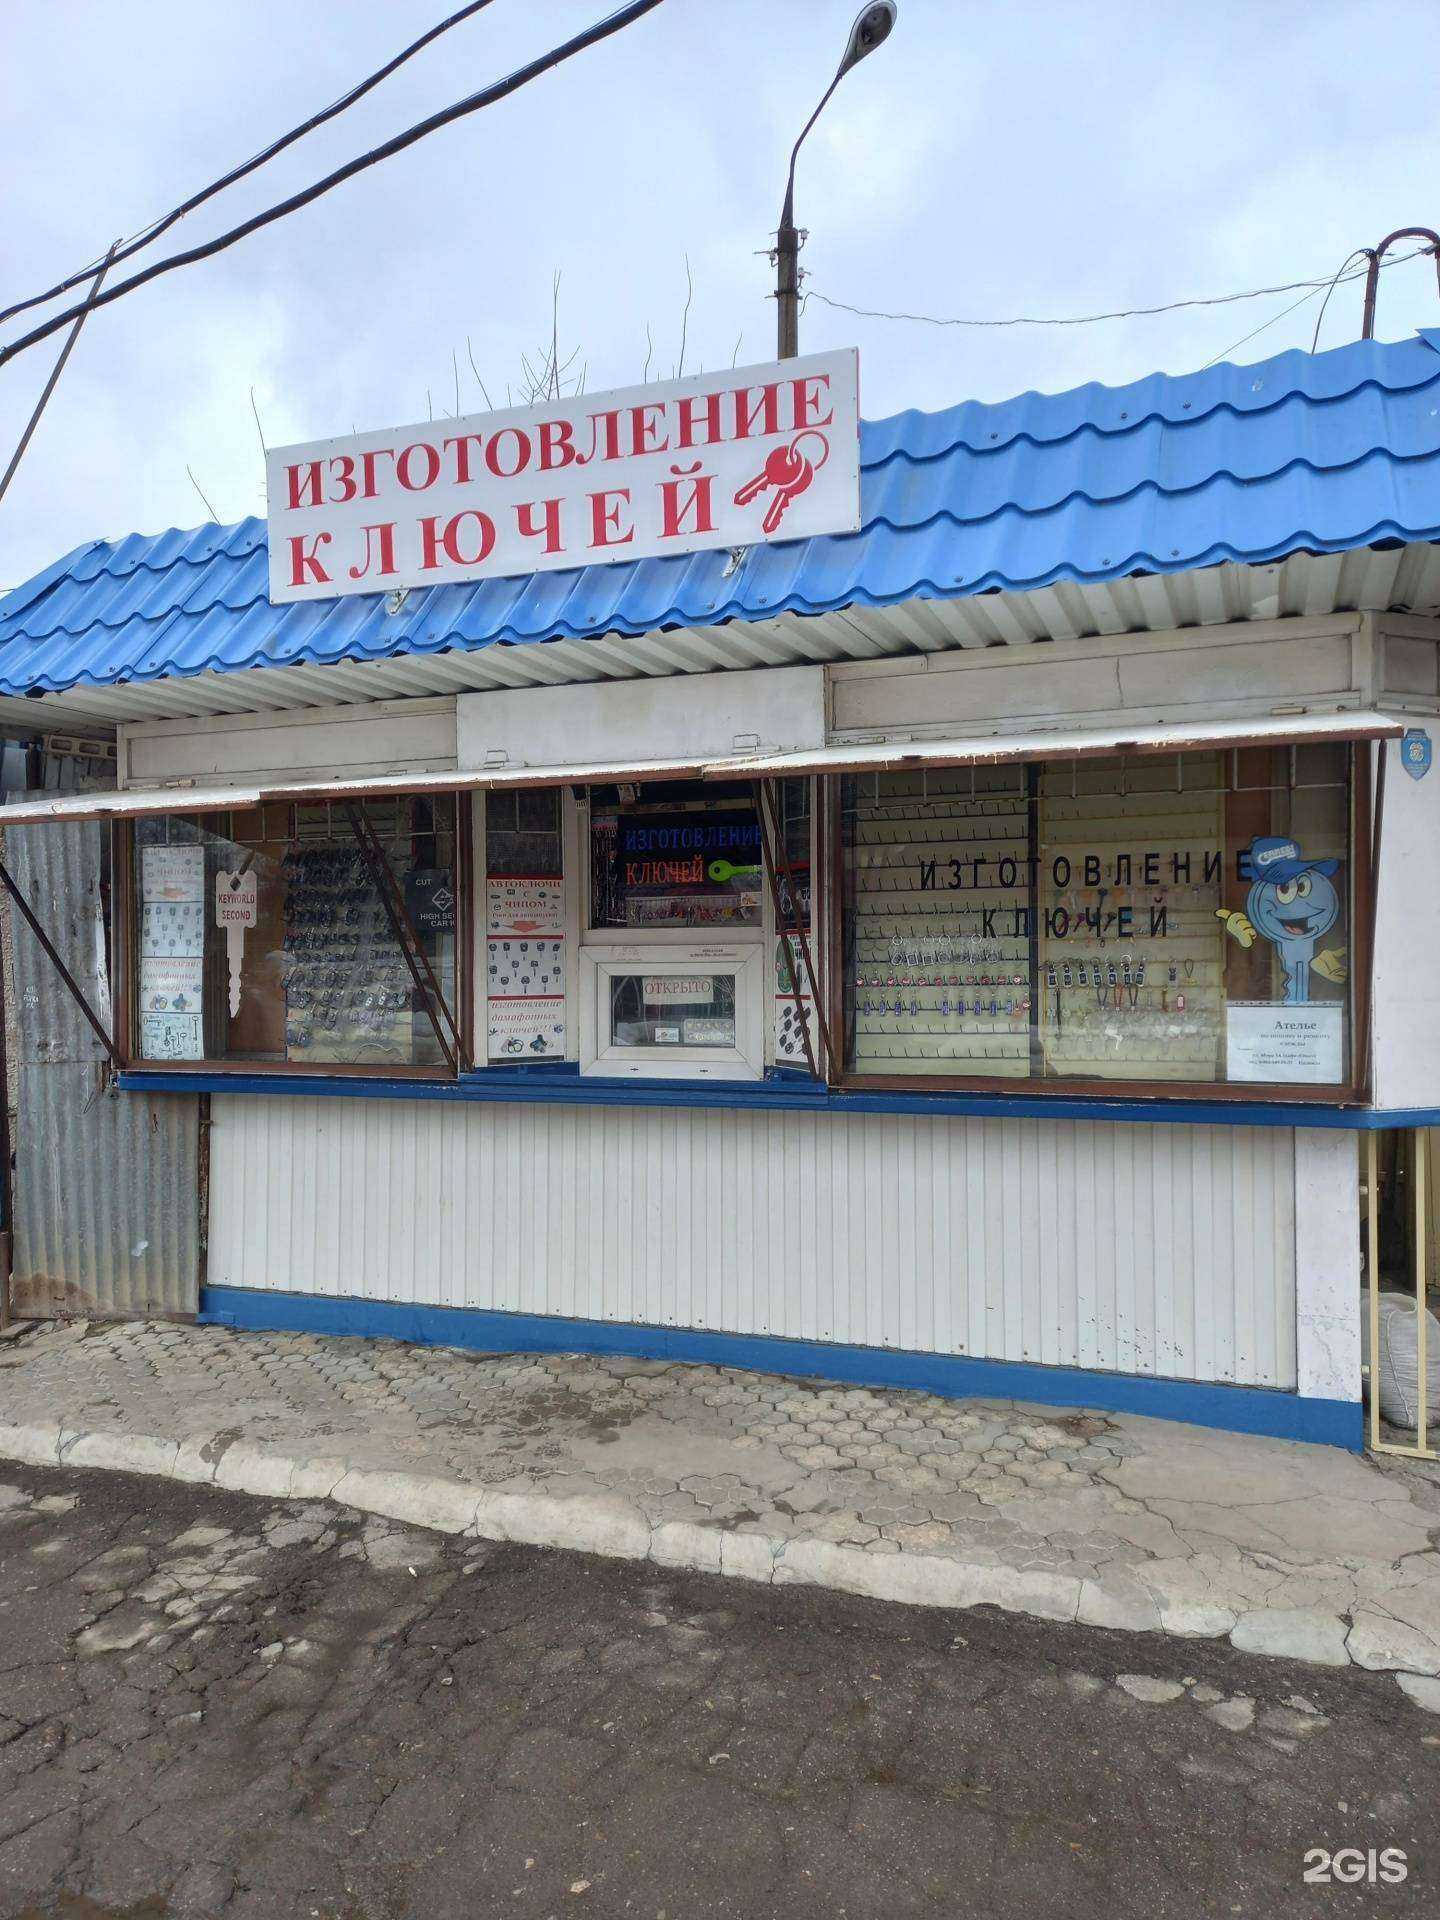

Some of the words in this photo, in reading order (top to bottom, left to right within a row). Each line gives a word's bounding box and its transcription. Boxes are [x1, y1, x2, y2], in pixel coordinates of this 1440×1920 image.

[283, 373, 834, 511] ИЗГОТОВЛЕНИЕ
[286, 461, 720, 588] КЛЮЧЕЙ
[625, 825, 763, 850] ИЗГОТОВЛЕНИЕ
[625, 853, 705, 885] КЛЮЧЕЙ
[920, 850, 1255, 890] ИЗГОТОВЛЕНИЕ
[415, 878, 432, 886] CUT
[488, 880, 561, 888] АВТОКЛЮЧИ
[218, 893, 255, 904] KEYWORLD
[504, 900, 547, 908] ЧИПОМ
[222, 910, 251, 920] SECOND
[420, 912, 440, 920] HIGH
[981, 897, 1168, 939] КЛЮЧЕЙ
[644, 980, 712, 995] ОТКРЫТО
[1274, 1020, 1318, 1031] Ателье
